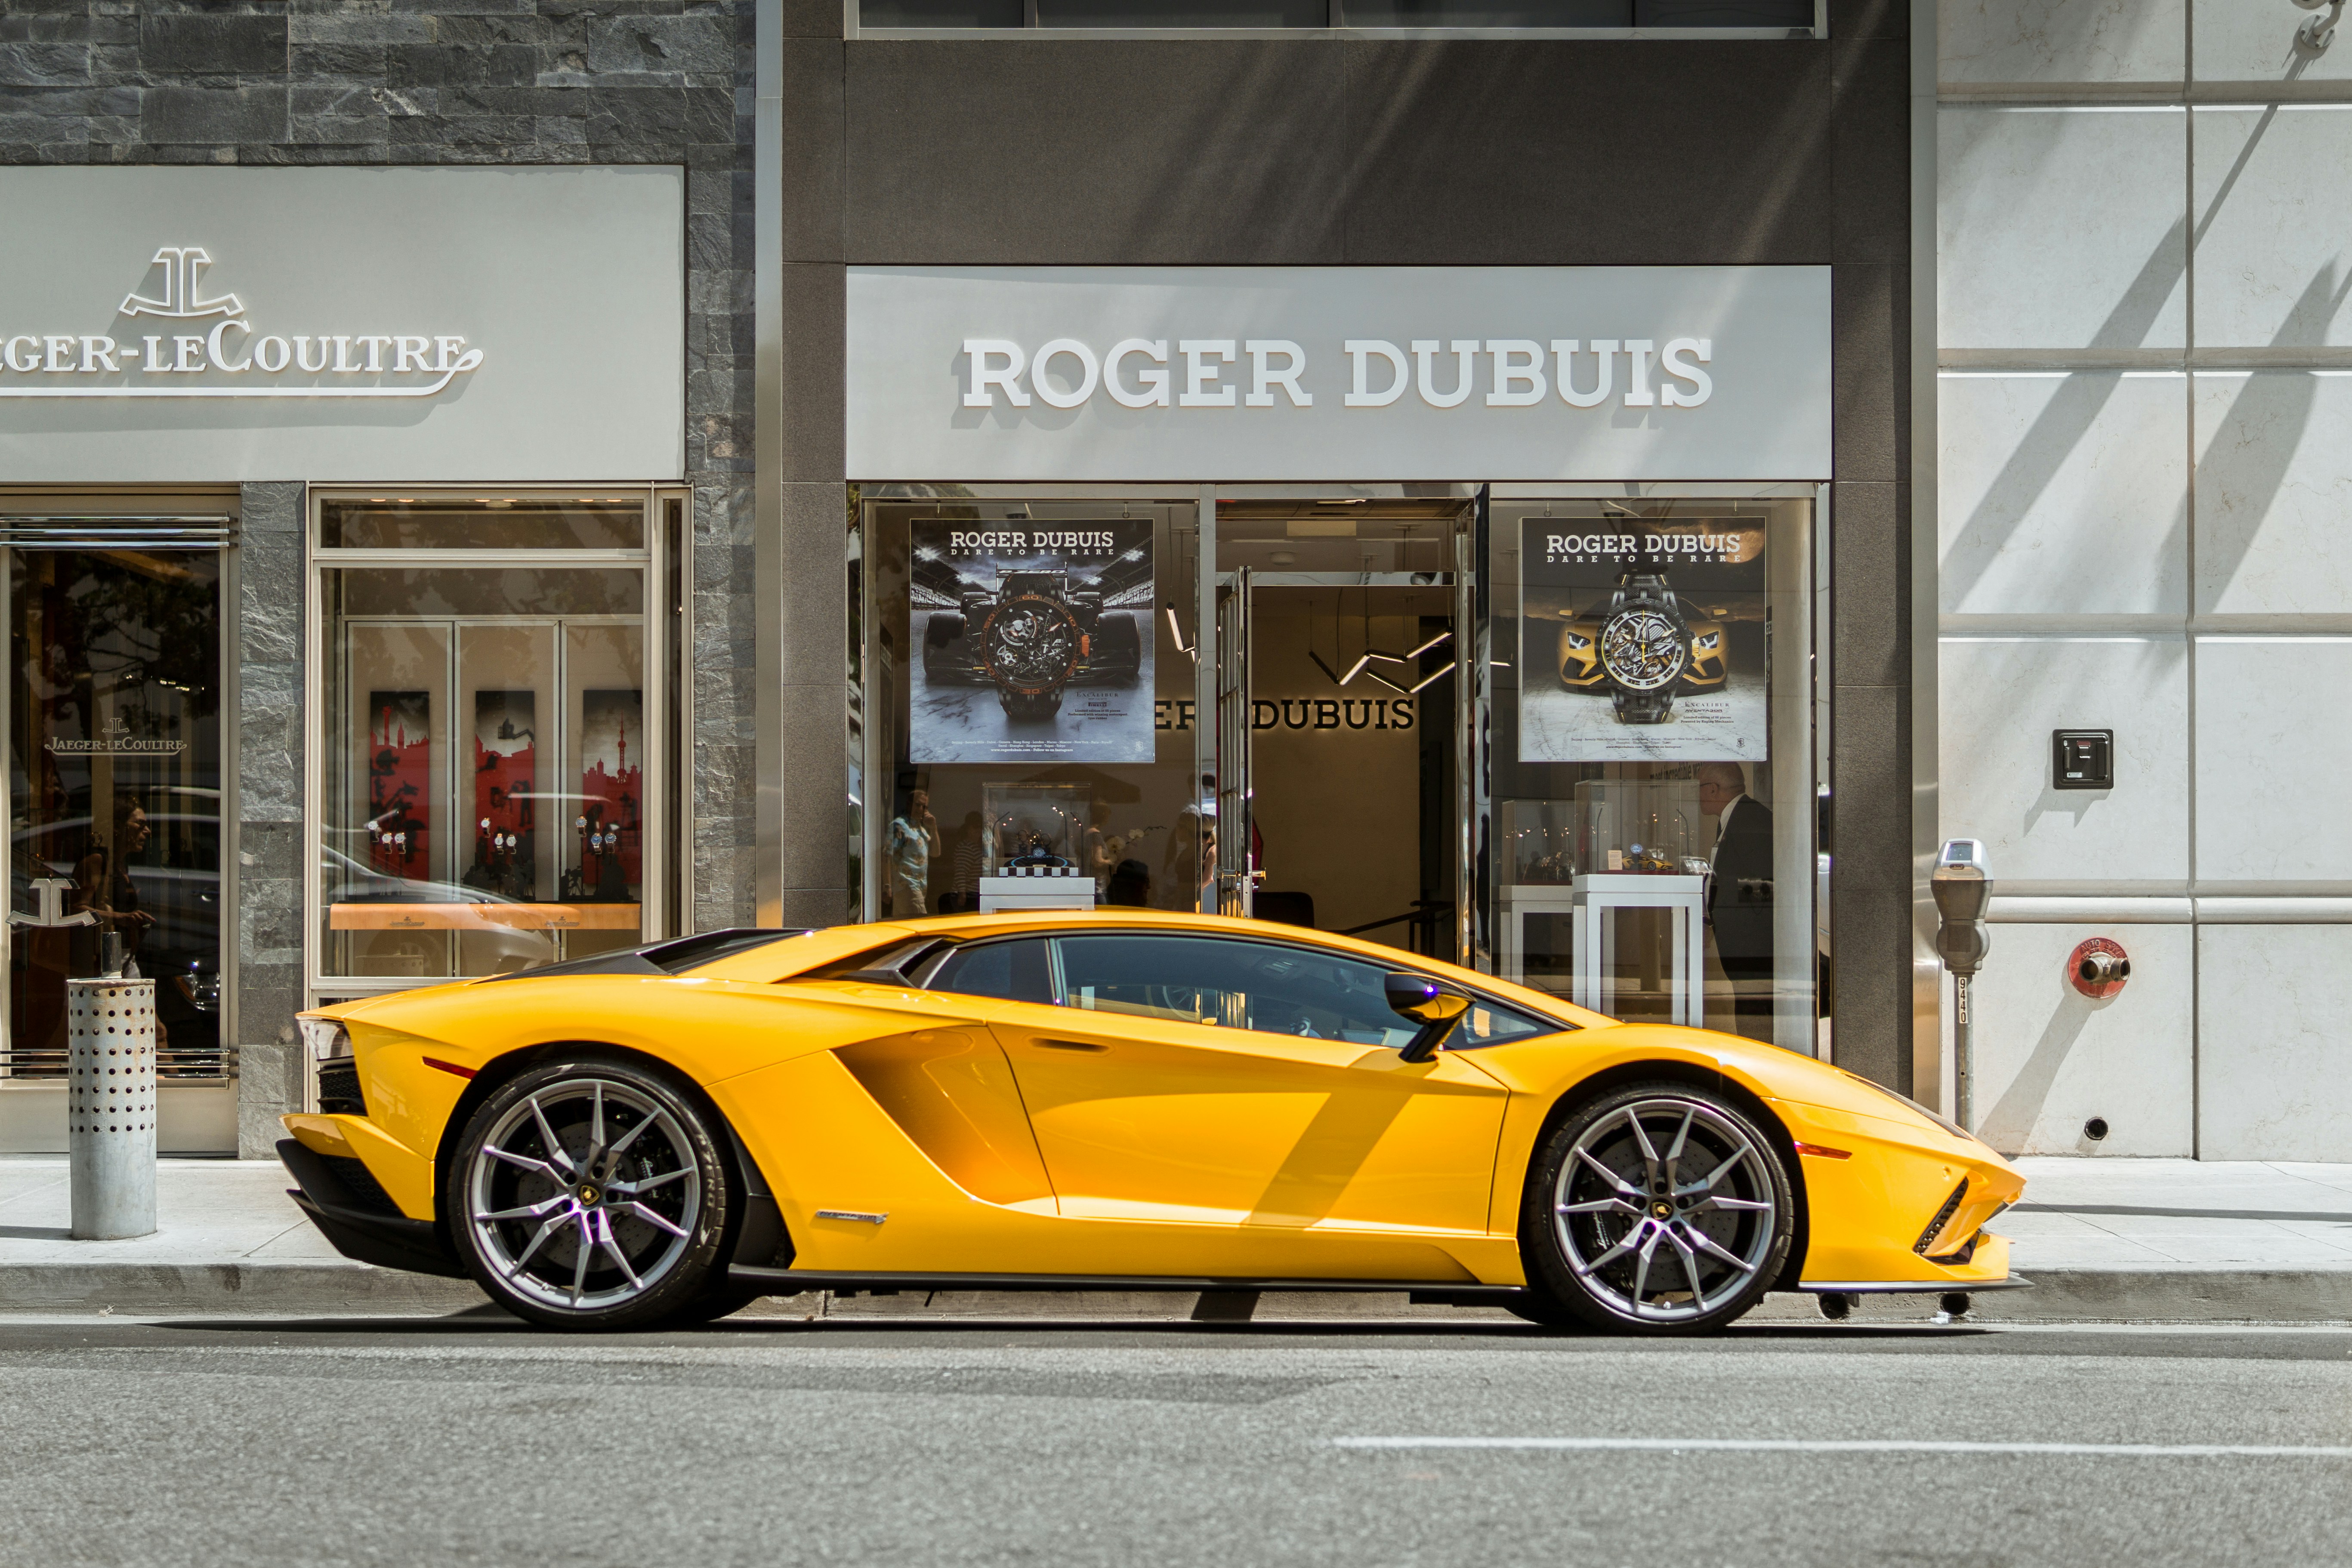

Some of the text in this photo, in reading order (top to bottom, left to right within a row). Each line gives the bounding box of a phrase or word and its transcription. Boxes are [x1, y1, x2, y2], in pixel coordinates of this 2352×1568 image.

[0, 320, 484, 372] GER-LECOULTRE
[963, 339, 1713, 408] ROGER DUBUIS
[951, 532, 1114, 547] ROGER DUBUIS
[1546, 535, 1741, 553] ROGER DUBUIS
[1252, 699, 1414, 730] DUBUIS
[2081, 939, 2100, 952] AUTO
